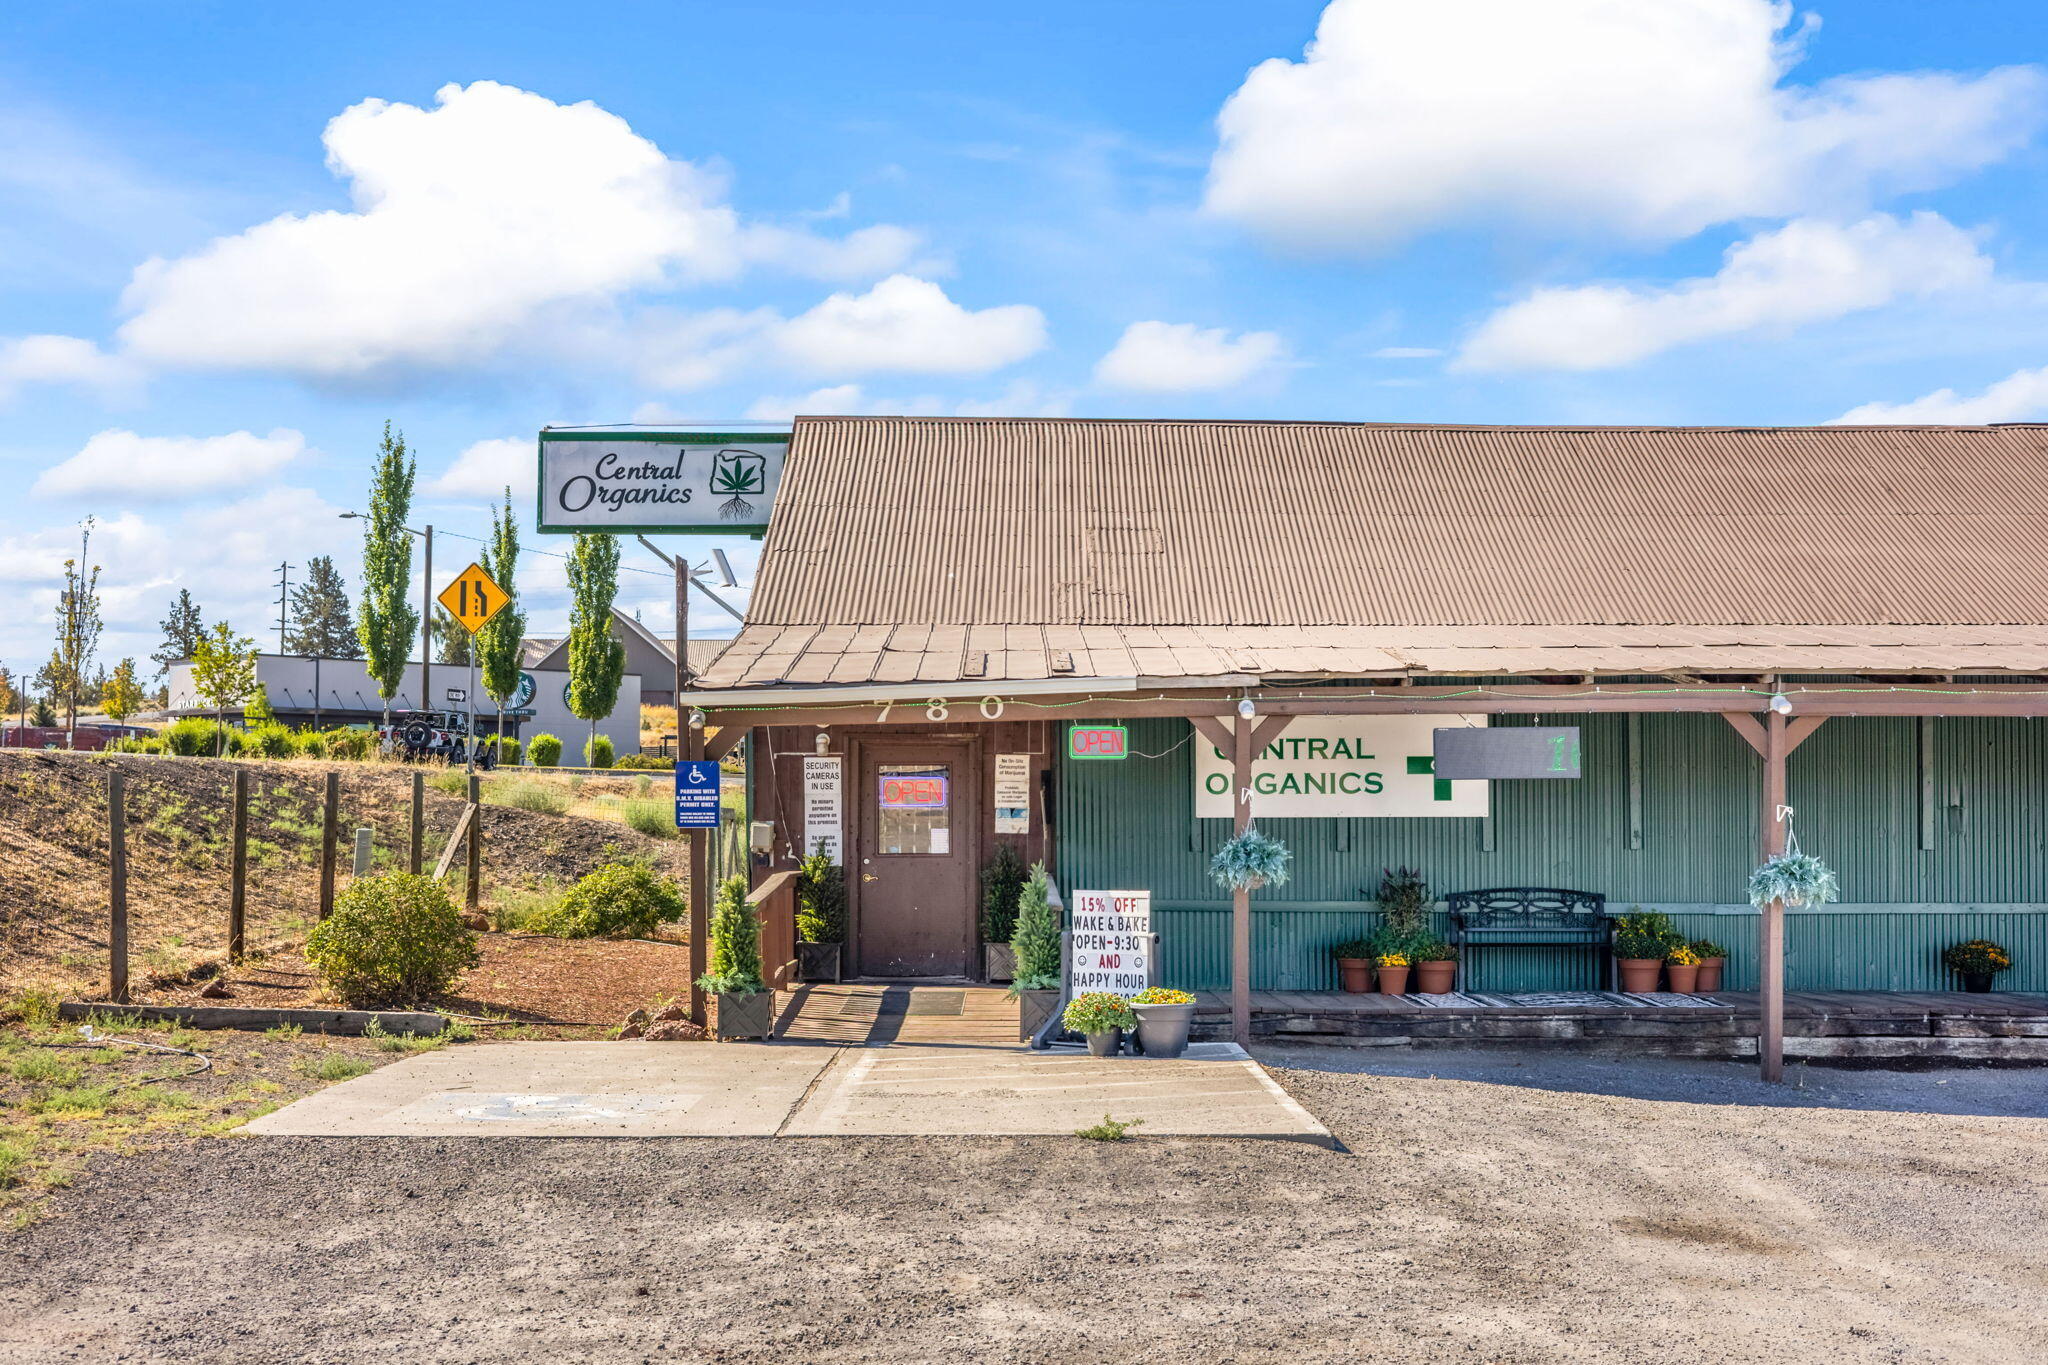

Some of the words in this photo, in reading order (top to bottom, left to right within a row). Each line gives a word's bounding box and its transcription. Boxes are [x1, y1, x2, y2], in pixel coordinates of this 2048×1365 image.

[594, 449, 686, 480] Central
[559, 475, 693, 512] Organics
[1072, 730, 1124, 753] OPEN
[1213, 737, 1376, 760] NTRAL
[805, 761, 840, 770] SECURITY
[805, 772, 840, 780] CAMERAS
[1205, 772, 1385, 796] OGANICS
[811, 782, 819, 790] IN
[820, 782, 834, 790] USE
[884, 780, 943, 803] OPEN
[1081, 896, 1106, 913] 15%
[1114, 897, 1137, 913] OFF
[1073, 916, 1105, 931] WAKE
[1107, 916, 1115, 931] &
[1117, 916, 1148, 932] BAKE
[1098, 954, 1121, 969] AND
[1073, 972, 1111, 988] HAPPY
[1115, 973, 1145, 989] HOUR
